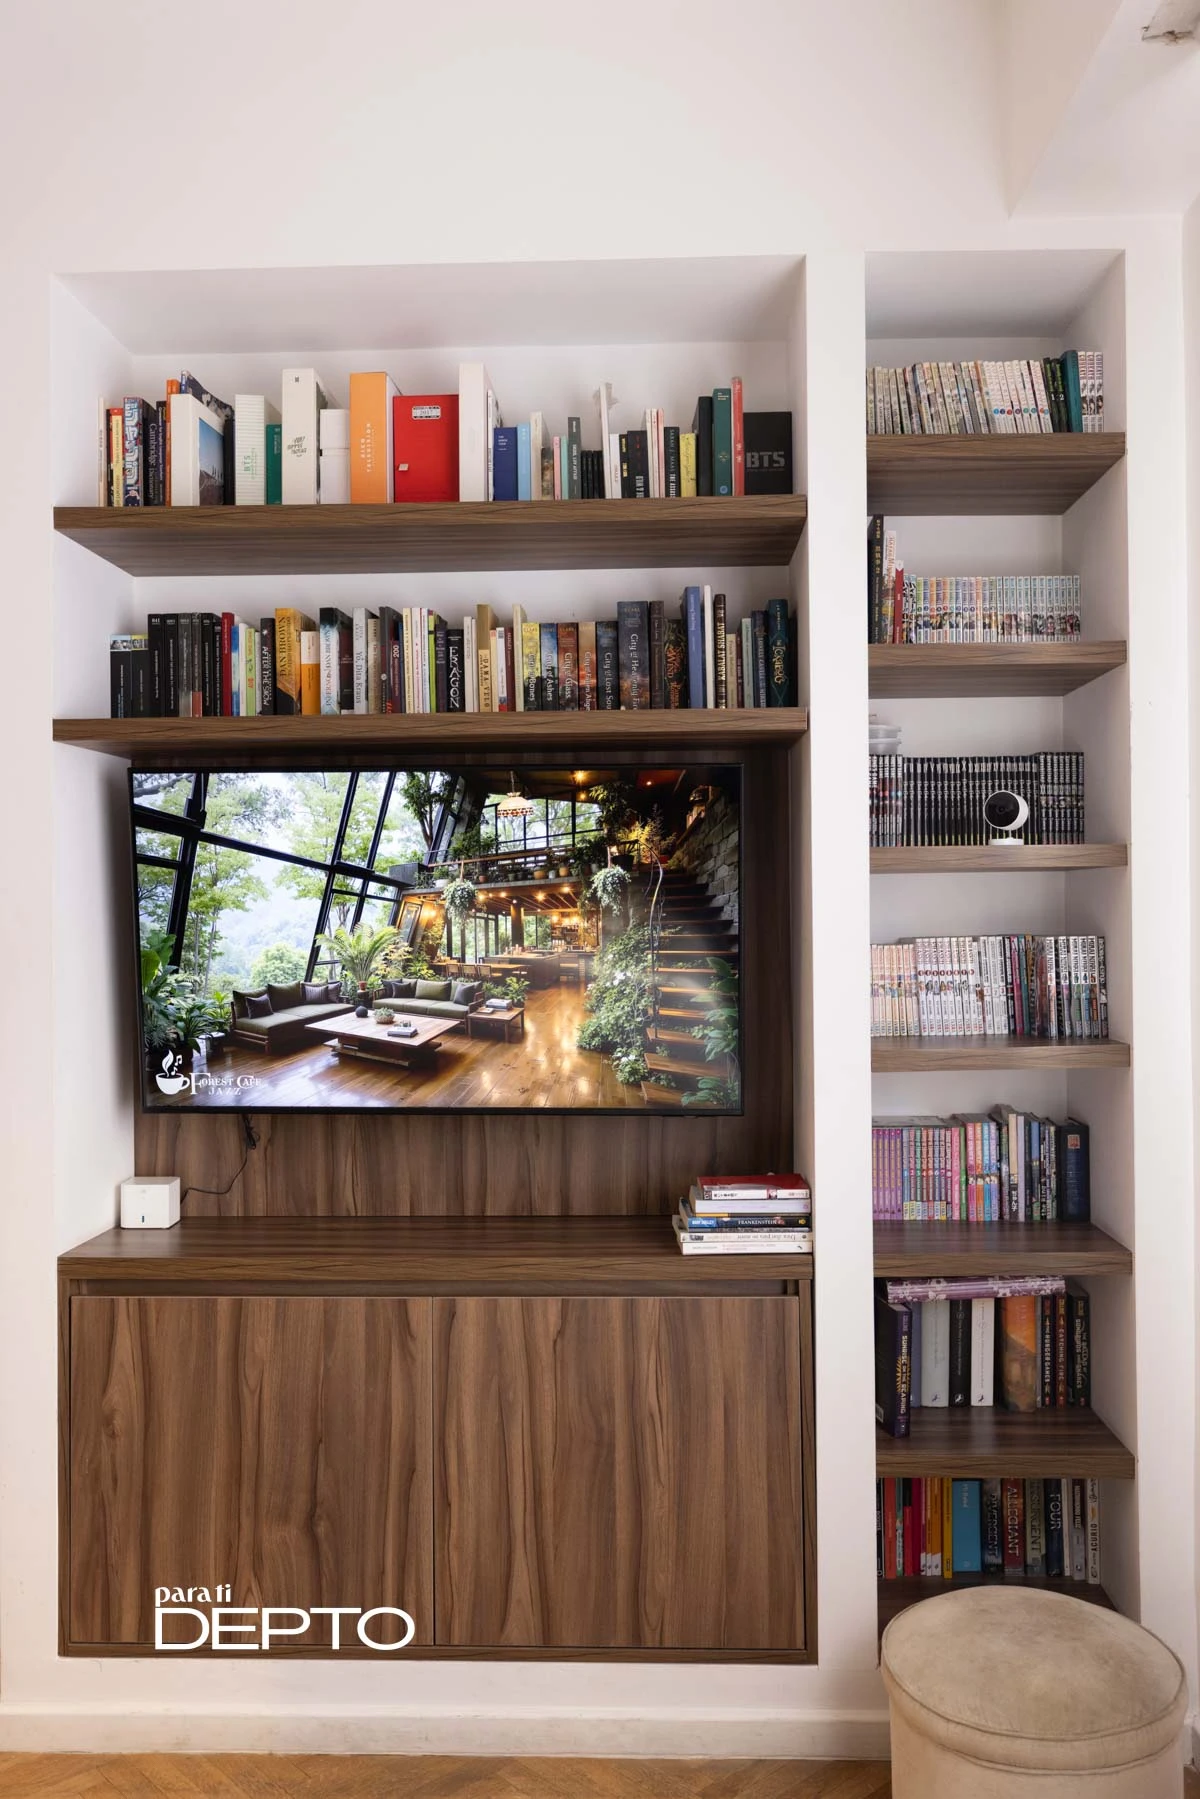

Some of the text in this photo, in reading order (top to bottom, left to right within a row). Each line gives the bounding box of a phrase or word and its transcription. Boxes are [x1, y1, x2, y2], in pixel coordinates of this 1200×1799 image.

[147, 423, 158, 500] Cambridge Dictionary
[746, 451, 785, 468] BTS
[278, 616, 287, 676] DAN BROWN
[392, 645, 400, 658] 200
[629, 634, 638, 650] City
[717, 622, 726, 680] KABALAT SHABAT
[262, 646, 270, 669] AFTER
[564, 652, 572, 669] City
[604, 652, 612, 668] City
[665, 649, 677, 678] WIND
[771, 645, 786, 684] ICKABOG
[356, 664, 364, 681] Dita
[449, 646, 462, 709] ERAGON
[631, 660, 639, 696] Heavenly
[263, 686, 271, 706] SNOW
[355, 682, 363, 703] Kraus
[564, 678, 573, 699] Glass
[188, 1072, 234, 1095] FOREST
[1007, 1486, 1019, 1557] ALLEGIANT
[1049, 1493, 1062, 1531] FOUR
[988, 1493, 998, 1557] DIVERGENT
